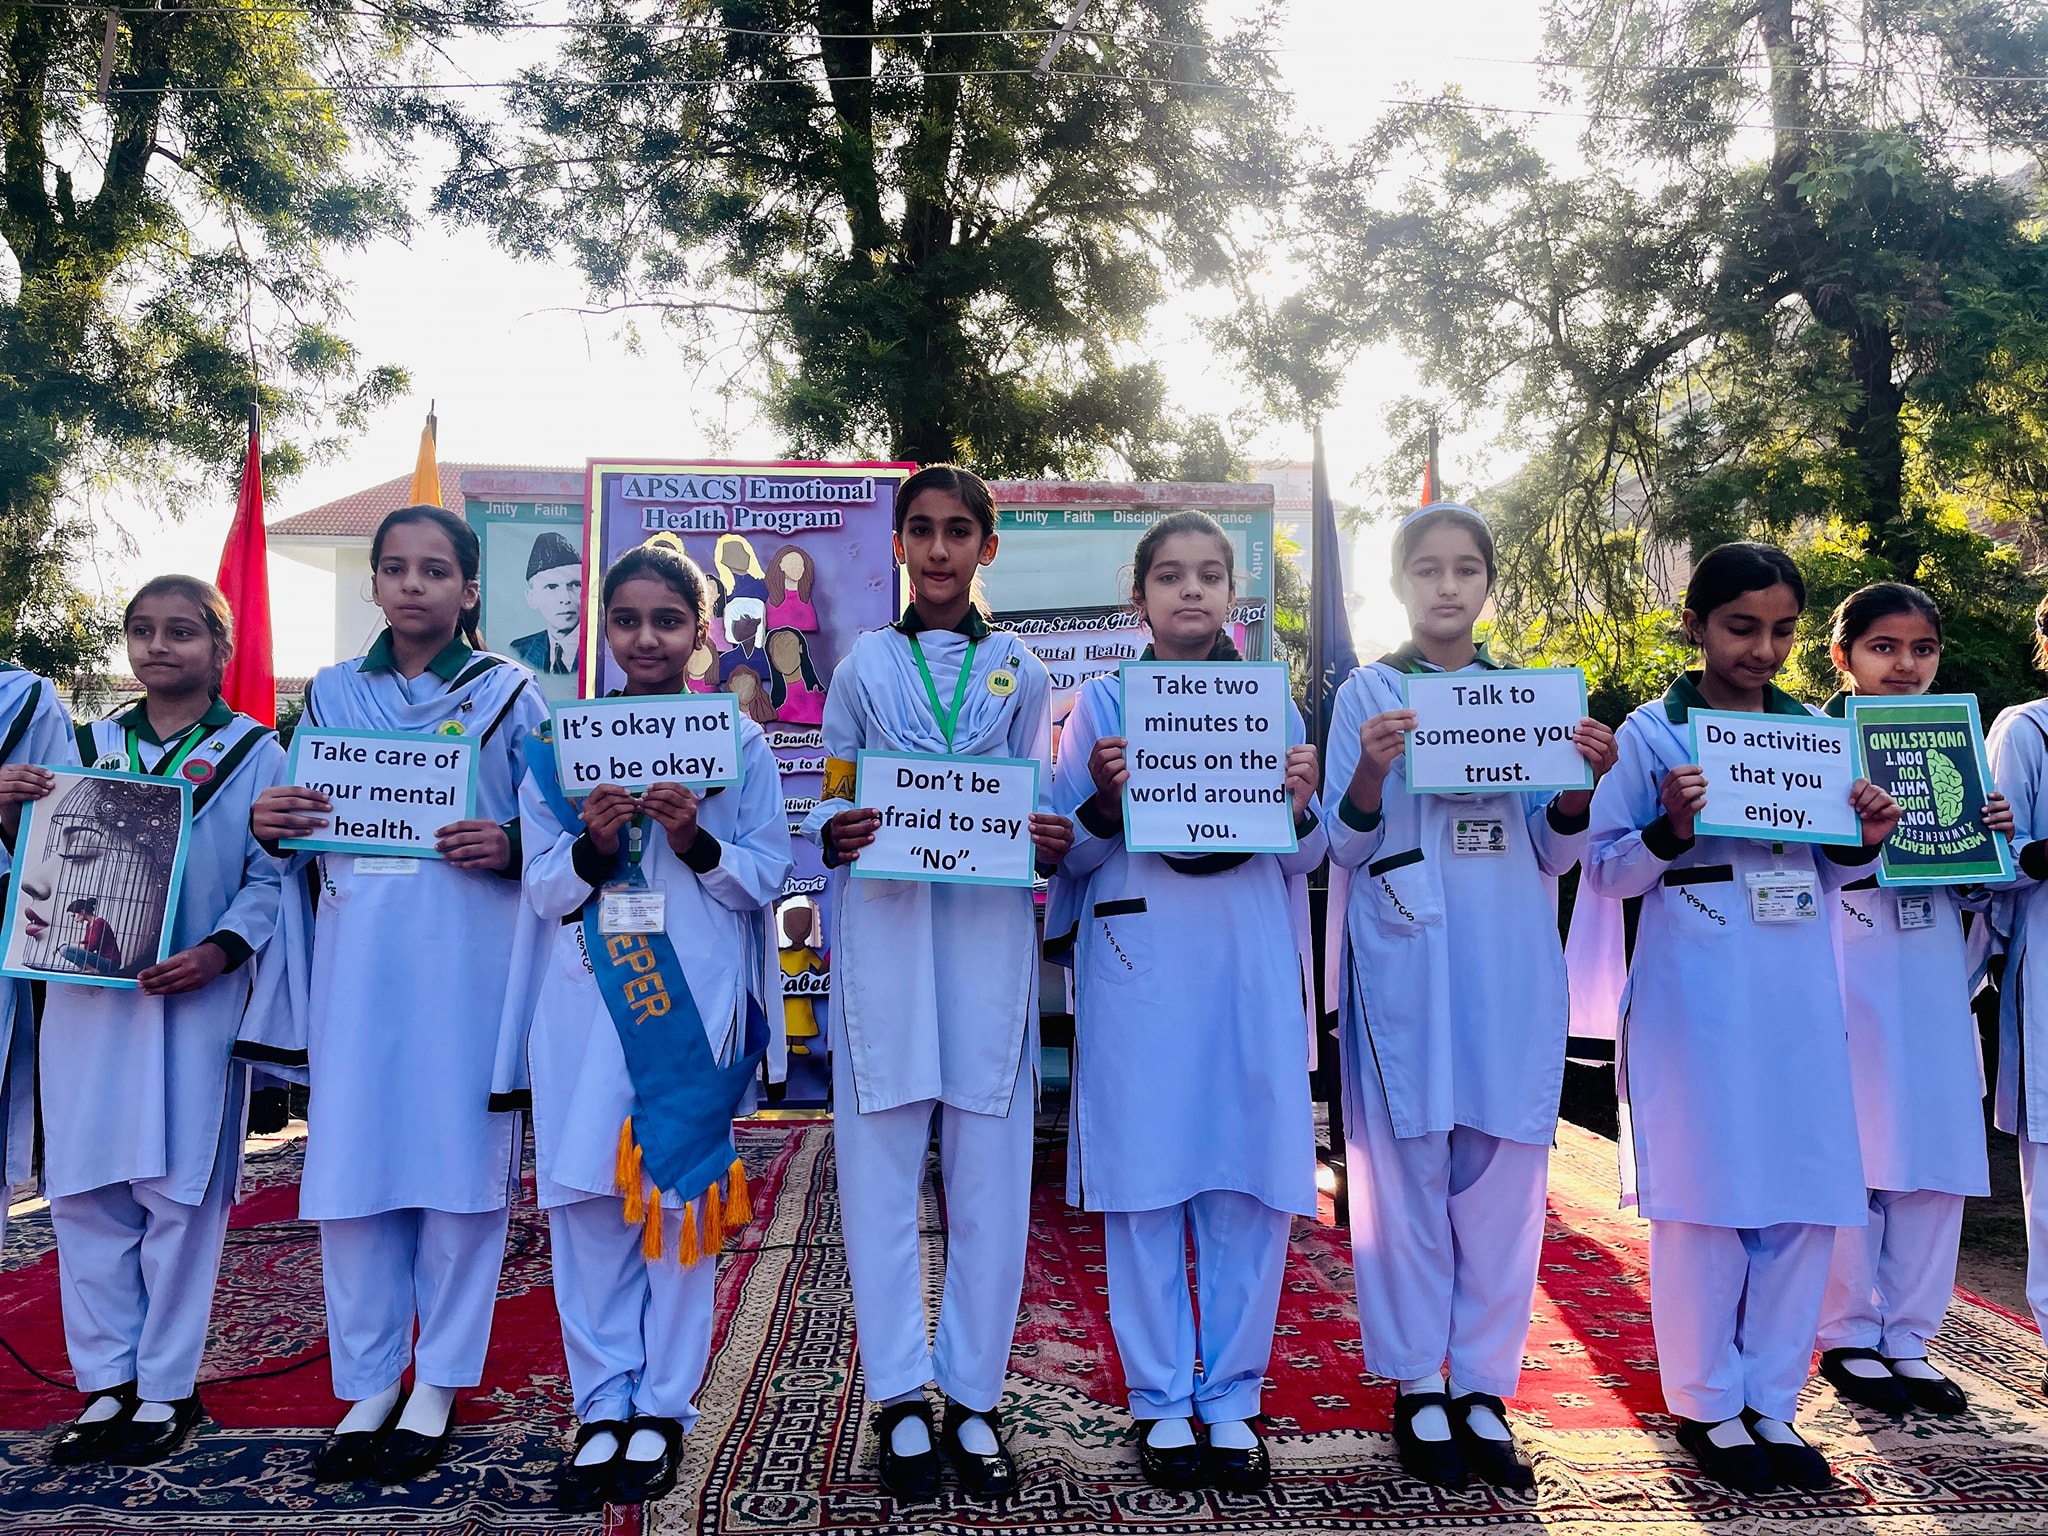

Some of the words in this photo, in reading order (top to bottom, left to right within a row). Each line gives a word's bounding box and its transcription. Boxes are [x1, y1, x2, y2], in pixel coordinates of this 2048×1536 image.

[624, 477, 738, 500] APSACS
[750, 479, 873, 500] Emotional
[534, 503, 568, 516] Faith
[644, 508, 727, 530] Health
[733, 507, 842, 532] Program
[1015, 511, 1049, 526] Unity
[1063, 511, 1095, 524] Faith
[1250, 541, 1264, 580] Unity
[1051, 616, 1106, 632] School
[1107, 612, 1140, 629] Girl
[1084, 643, 1137, 659] Health
[1152, 674, 1207, 695] Take
[1214, 676, 1259, 695] two
[1452, 684, 1504, 706] Talk
[1509, 686, 1536, 704] to
[611, 712, 676, 738] okay
[685, 711, 730, 732] not
[1144, 712, 1238, 732] minutes
[1244, 714, 1269, 732] to
[773, 732, 823, 746] Beautif
[1415, 727, 1526, 746] someone
[1706, 724, 1736, 745] Do
[1743, 730, 1842, 754] activities
[1869, 731, 1967, 750] UNDERSTAND
[310, 741, 367, 763] Take
[375, 749, 427, 767] care
[434, 749, 460, 769] of
[799, 759, 813, 769] to
[1135, 749, 1197, 770] focus
[1204, 754, 1233, 770] on
[1240, 749, 1278, 770] the
[1885, 751, 1924, 766] DON'T
[573, 761, 601, 782] to
[609, 756, 643, 779] be
[651, 752, 724, 779] okay.
[1464, 762, 1531, 783] trust.
[1729, 762, 1776, 785] that
[1781, 771, 1823, 791] you
[1898, 766, 1926, 780] YOU
[971, 772, 1001, 794] be
[1130, 783, 1197, 803] world
[1204, 783, 1286, 804] around
[1890, 781, 1930, 796] WHAT
[369, 785, 456, 806] mental
[1896, 796, 1930, 811] JUDG
[949, 811, 974, 832] to
[981, 817, 1022, 840] say
[1744, 802, 1813, 829] enjoy.
[334, 815, 421, 841] health.
[1186, 823, 1238, 843] you.
[1906, 825, 1967, 842] AWARENESS
[1889, 834, 1936, 856] HEALTH
[1937, 831, 1987, 856] MENTAL
[1381, 875, 1415, 922] APSACS
[1678, 886, 1727, 926] APSACS
[1840, 899, 1874, 928] SACS
[1102, 921, 1134, 971] APSACS
